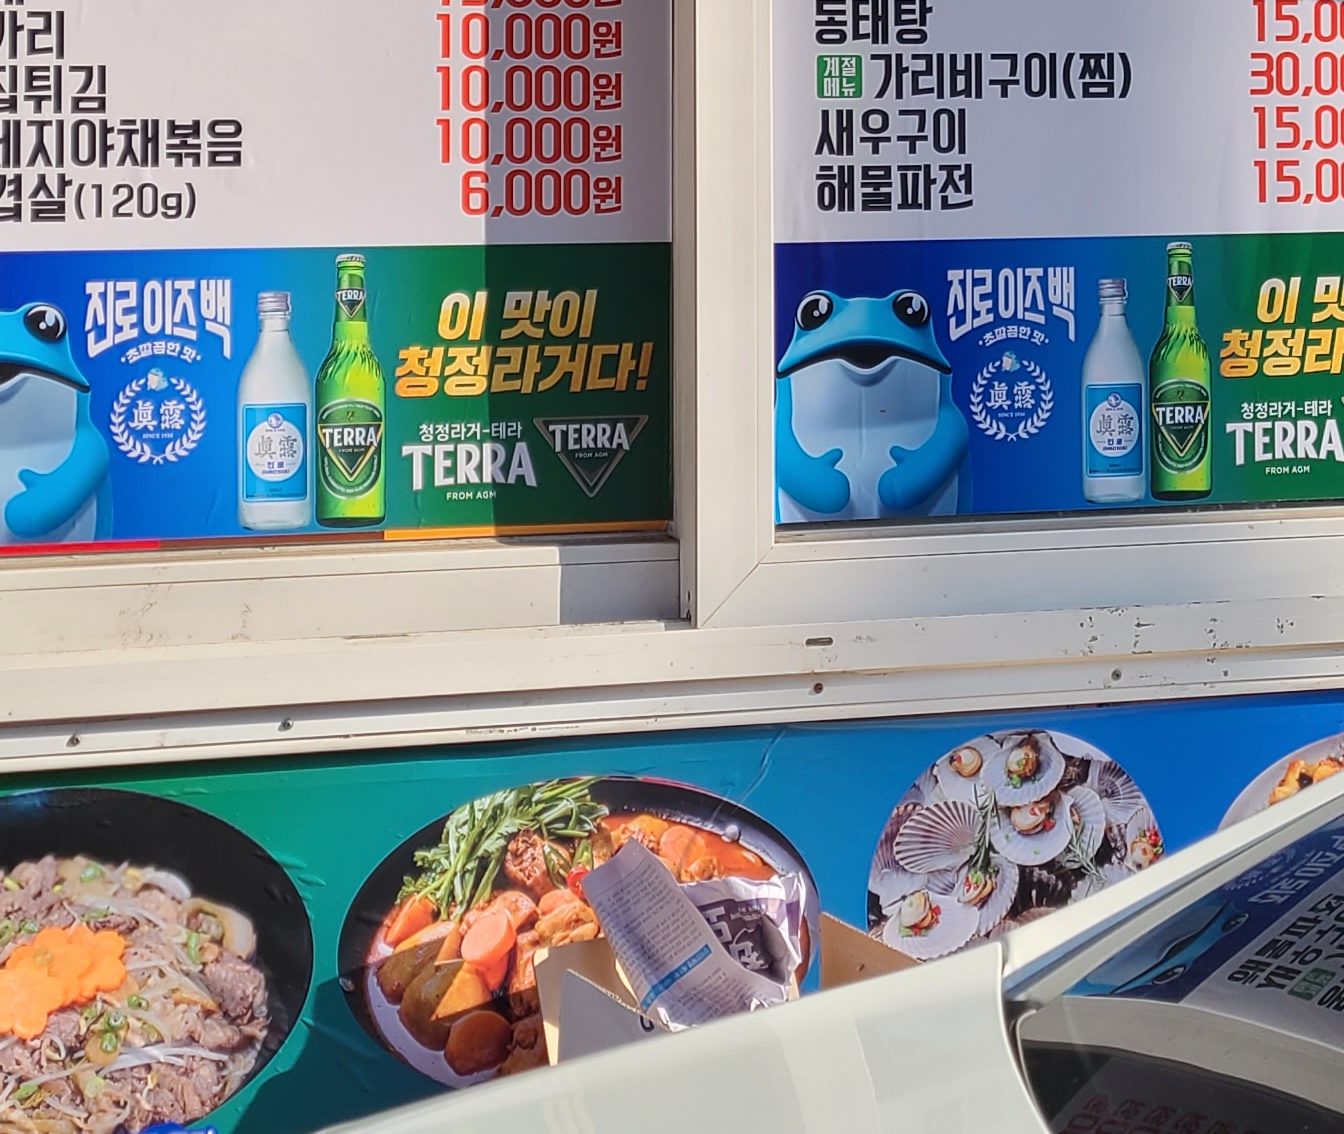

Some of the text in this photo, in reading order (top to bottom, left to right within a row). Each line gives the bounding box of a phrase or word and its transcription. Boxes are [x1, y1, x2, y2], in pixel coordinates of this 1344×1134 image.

[435, 11, 623, 61] 10,000원
[822, 56, 859, 77] 계절
[870, 52, 1132, 100] 가리비구이(찜)
[435, 63, 623, 114] 10,000원
[822, 76, 859, 98] 메뉴
[435, 116, 623, 166] 10,000원
[815, 108, 966, 156] 새우구이
[460, 168, 623, 218] 6,000원
[815, 163, 974, 212] 해물파전
[336, 289, 364, 302] TERRA
[1167, 275, 1192, 287] TERRA
[437, 289, 598, 341] 이 맛이
[1257, 277, 1302, 324] 이
[394, 342, 654, 398] 청정라거다!
[1156, 406, 1205, 426] TERRA
[1241, 400, 1333, 419] 청정라거-테라
[322, 426, 378, 449] TERRA
[418, 421, 523, 442] 청정라거-테라
[548, 423, 630, 453] TERRA
[402, 442, 538, 491] TERRA
[1265, 465, 1310, 474] FROM AGM
[446, 491, 496, 500] FROM AGM
